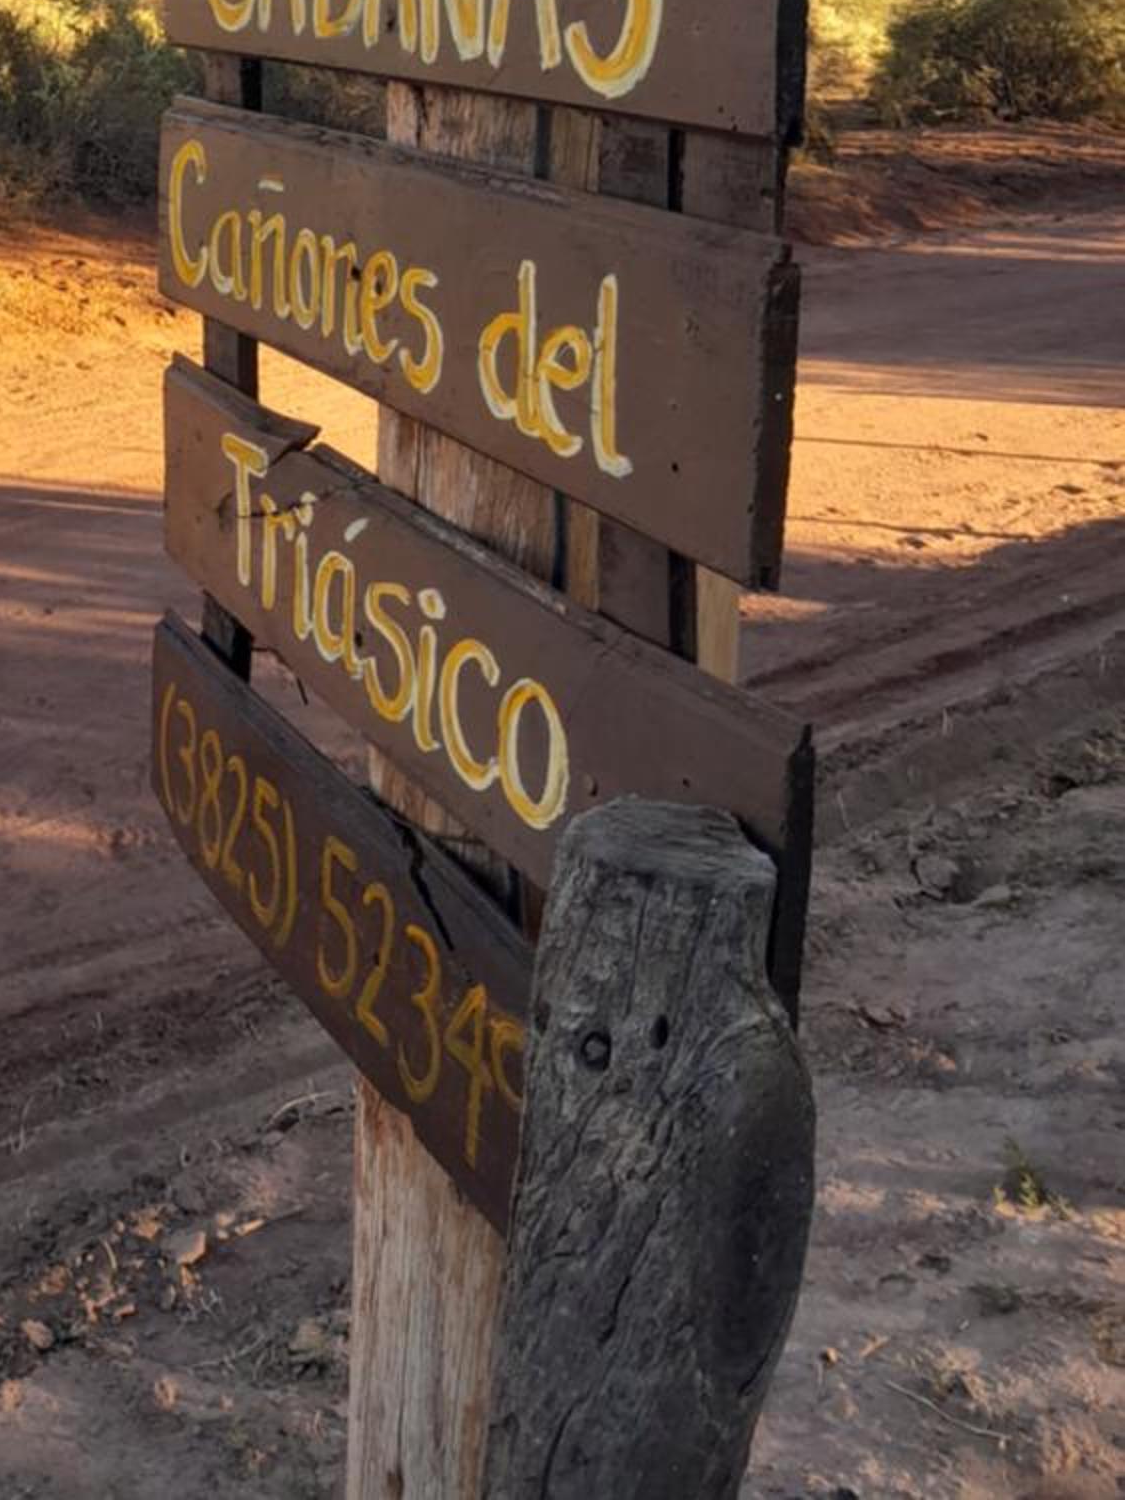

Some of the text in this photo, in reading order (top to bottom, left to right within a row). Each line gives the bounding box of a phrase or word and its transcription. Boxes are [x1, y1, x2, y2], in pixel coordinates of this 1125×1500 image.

[168, 140, 633, 478] Cañones del
[221, 433, 570, 831] Triásico
[160, 682, 298, 947] (3825)
